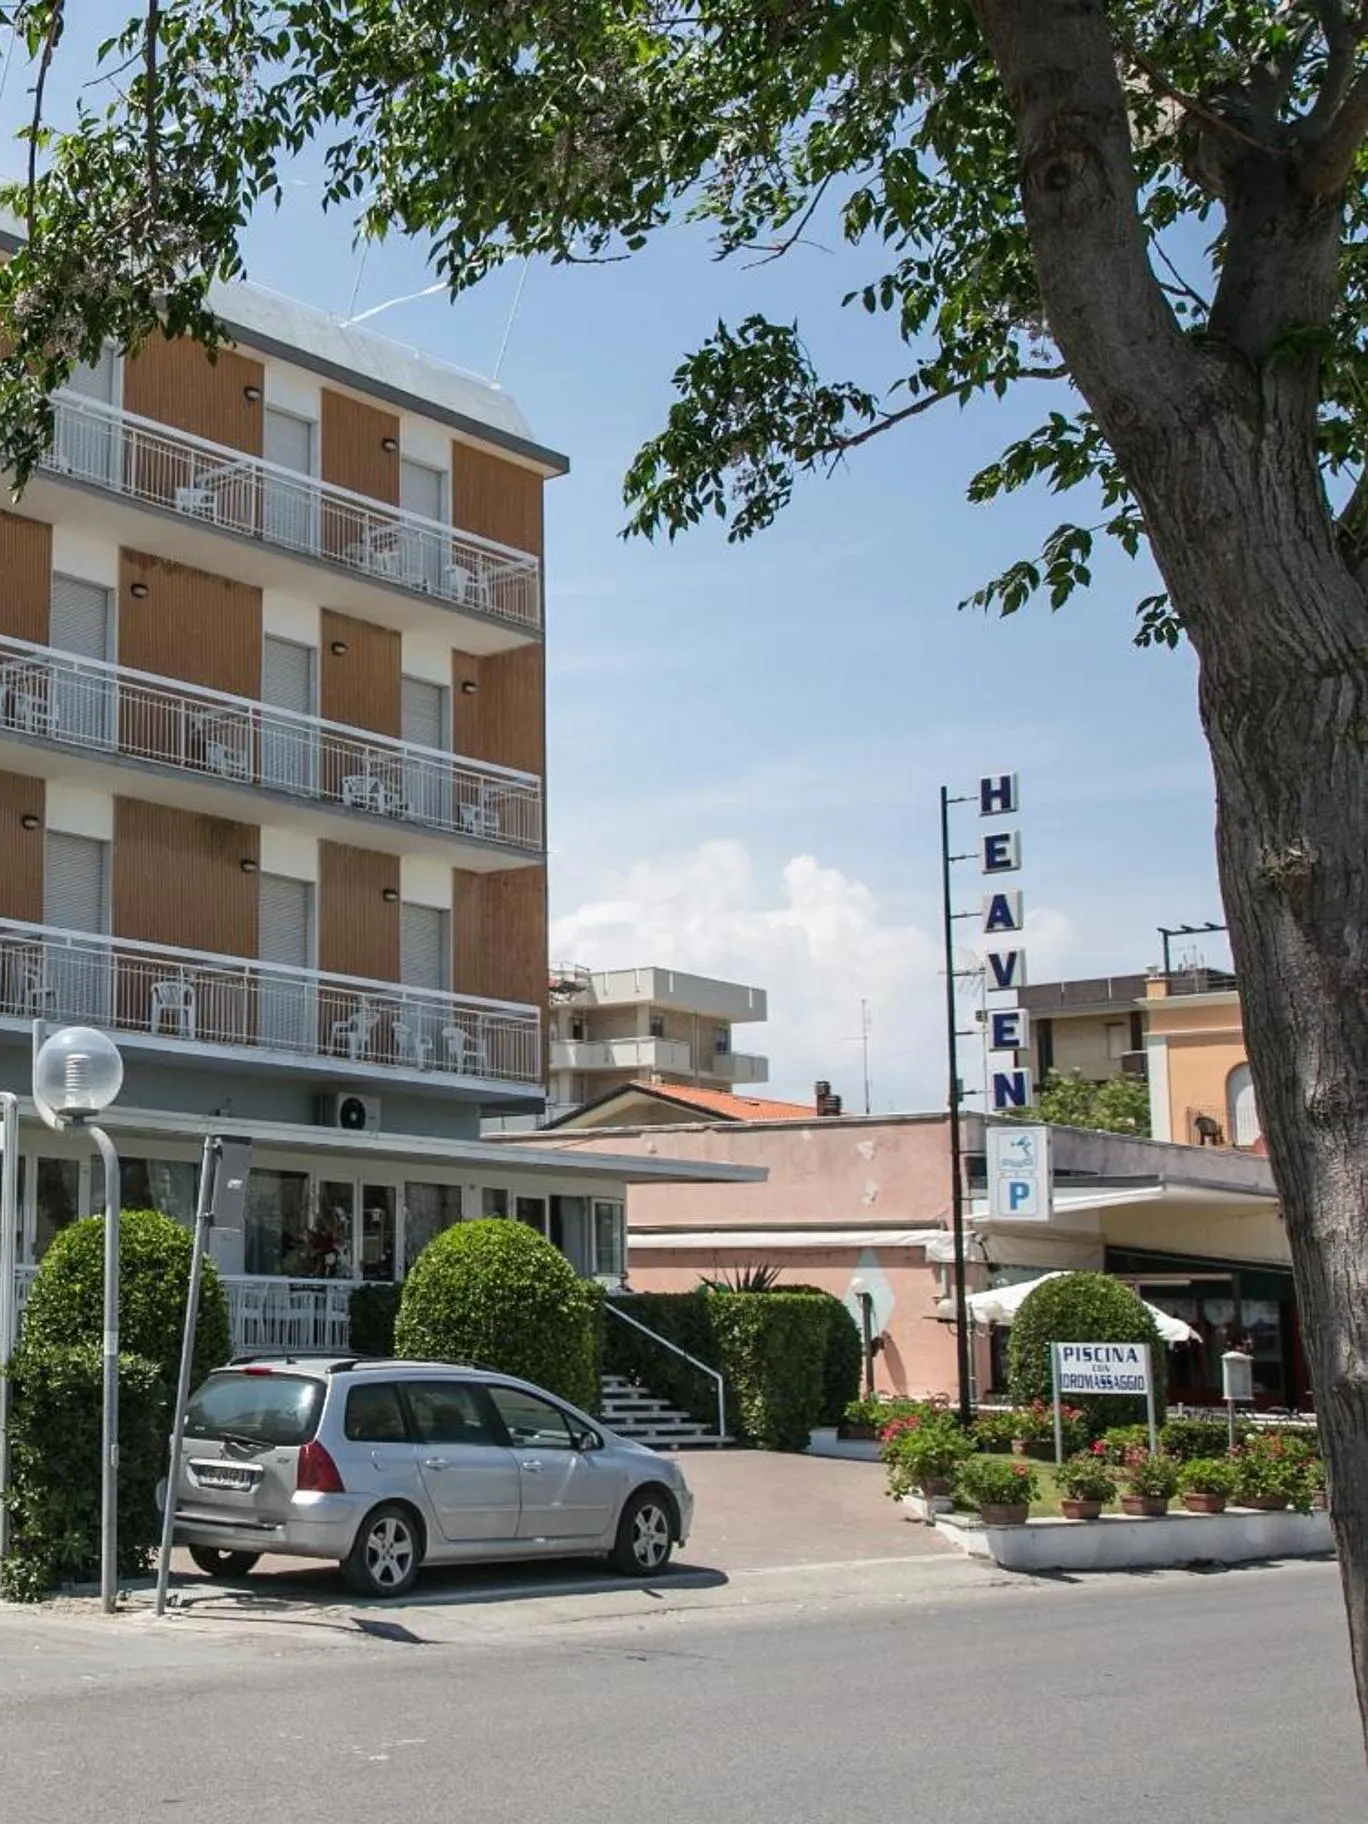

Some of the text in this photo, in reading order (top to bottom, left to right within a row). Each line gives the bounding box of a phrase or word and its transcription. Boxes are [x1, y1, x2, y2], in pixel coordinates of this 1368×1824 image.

[980, 775, 1026, 1108] HEAVEN
[1009, 1181, 1030, 1211] P
[1062, 1346, 1139, 1363] PISCINA
